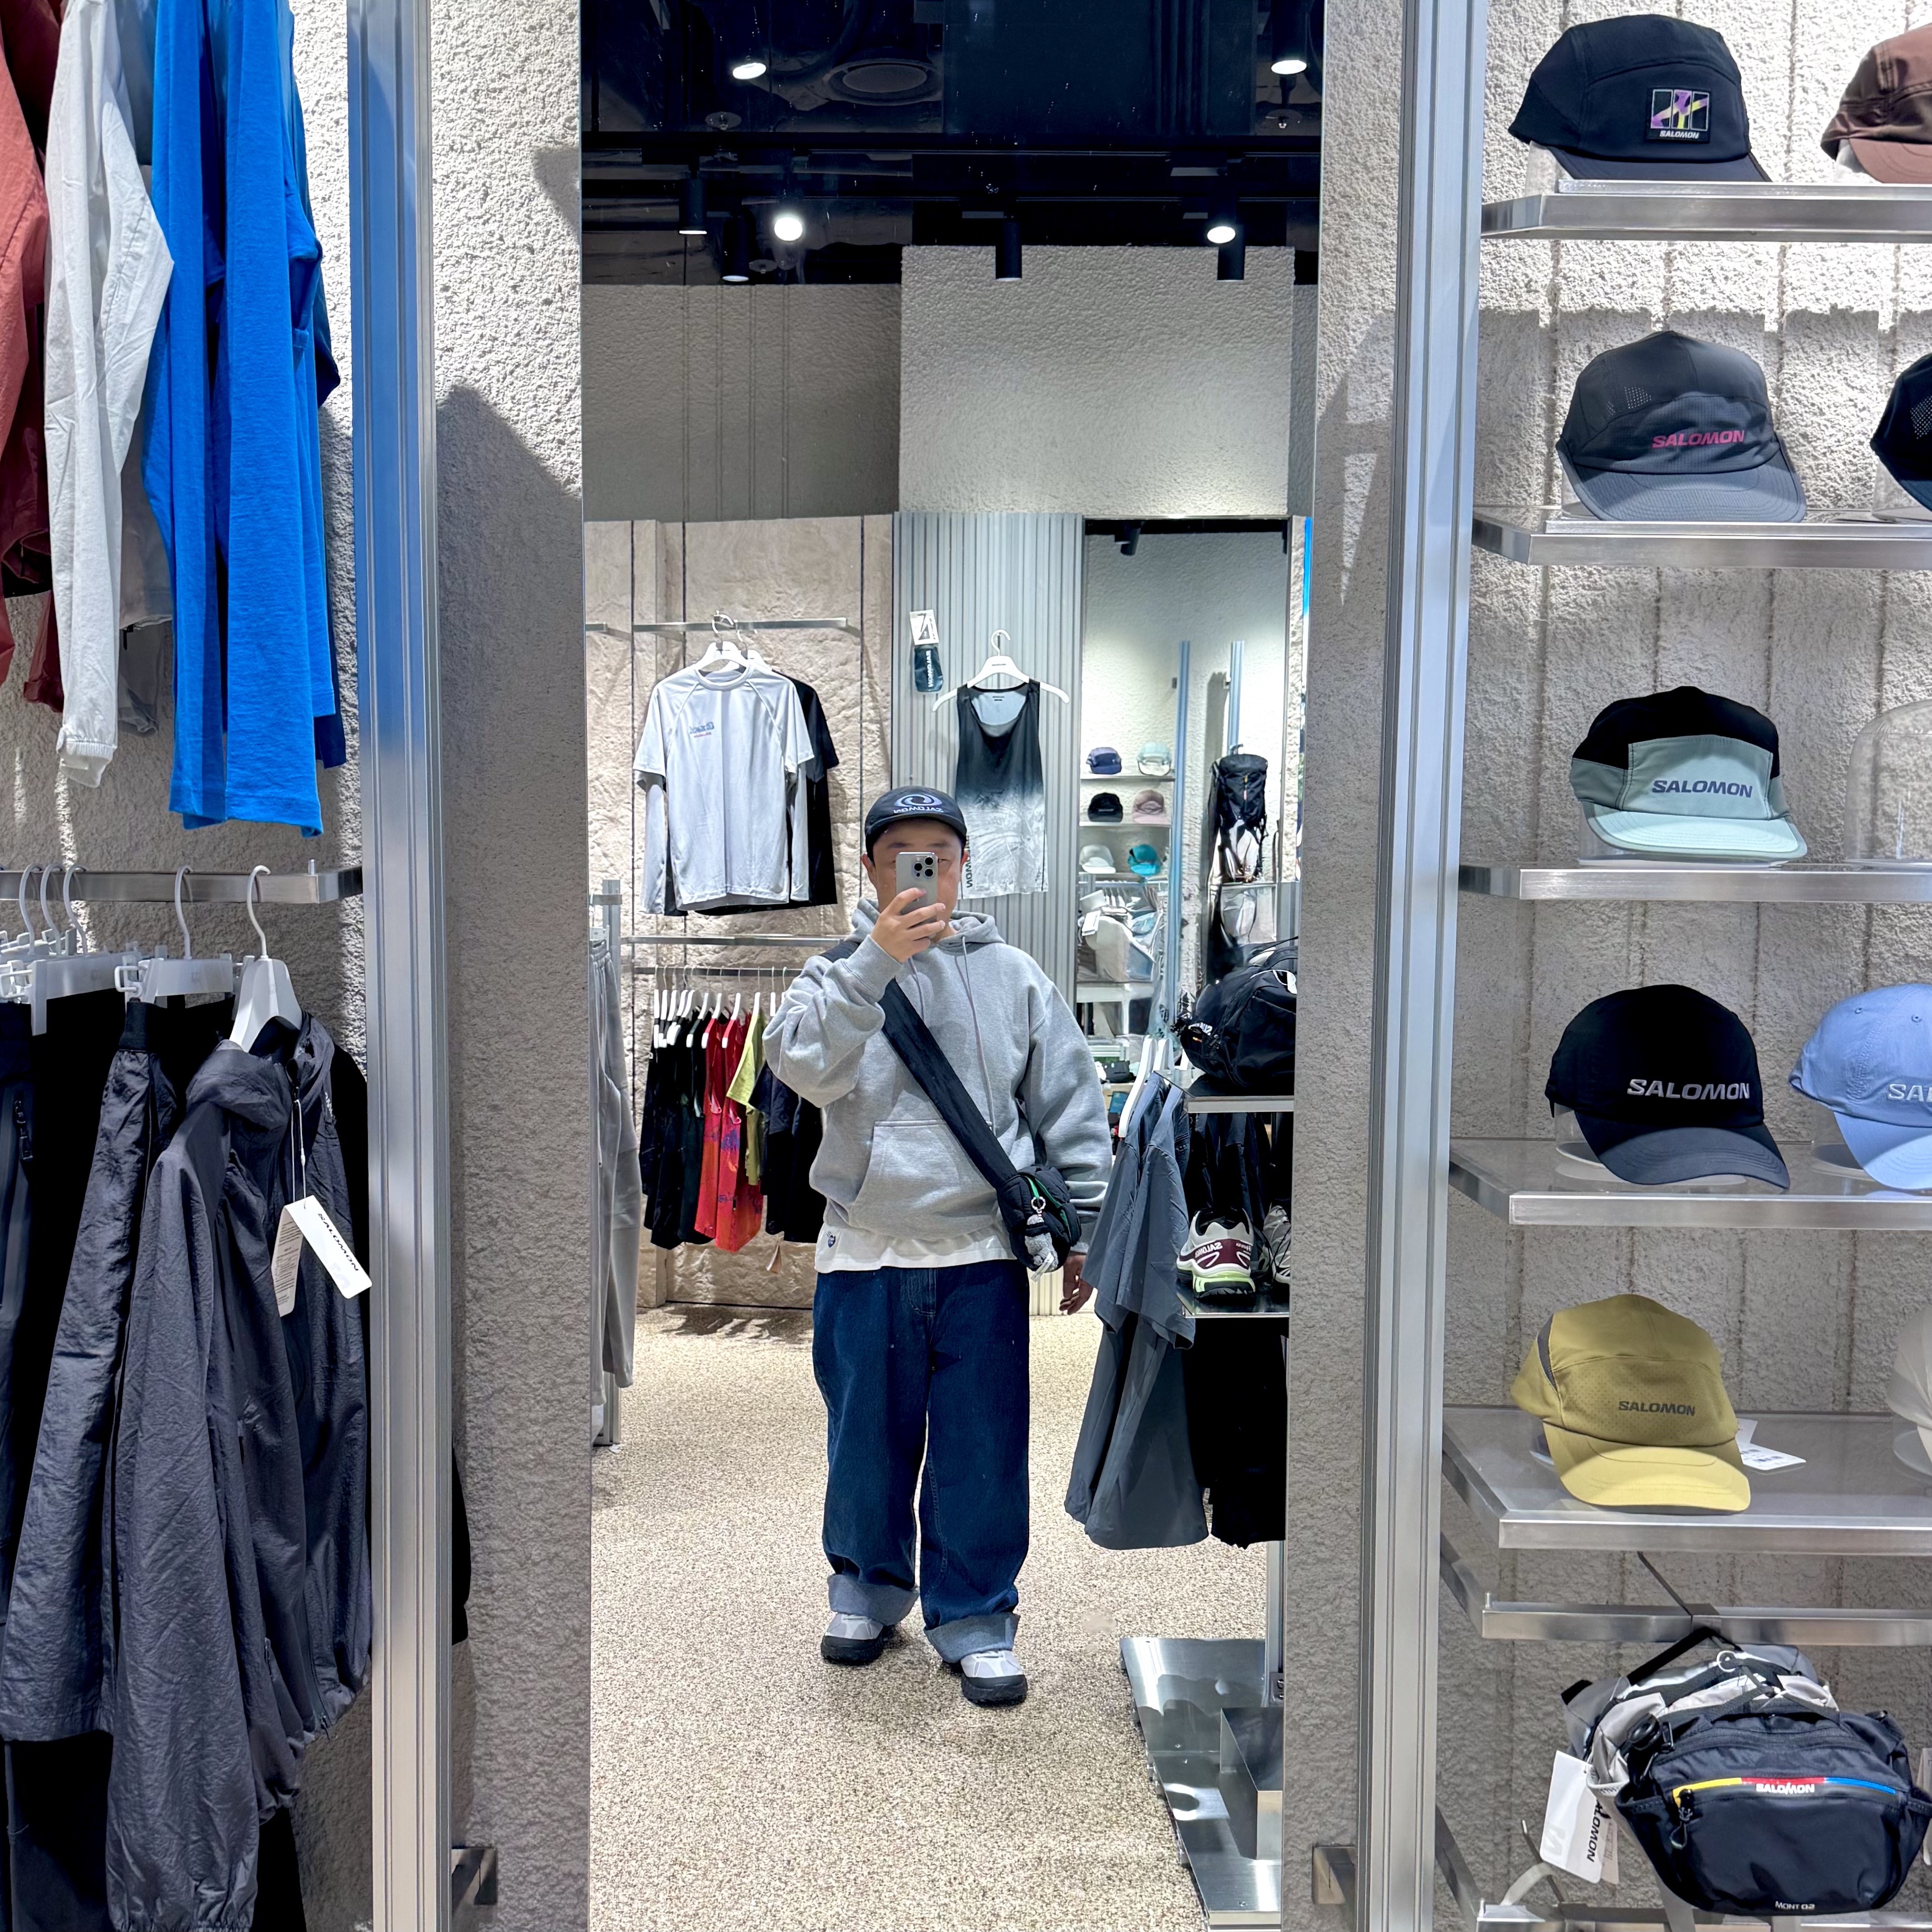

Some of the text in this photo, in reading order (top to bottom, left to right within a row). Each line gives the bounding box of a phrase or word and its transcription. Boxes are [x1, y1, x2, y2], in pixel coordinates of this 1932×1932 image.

[1660, 130, 1699, 139] SALOMON
[1652, 430, 1745, 448] SALOMON
[1652, 780, 1753, 798] SALOMON
[1627, 1079, 1750, 1100] SALOMON
[1618, 1401, 1695, 1416] SALOMON
[1756, 1782, 1815, 1795] SALOMON
